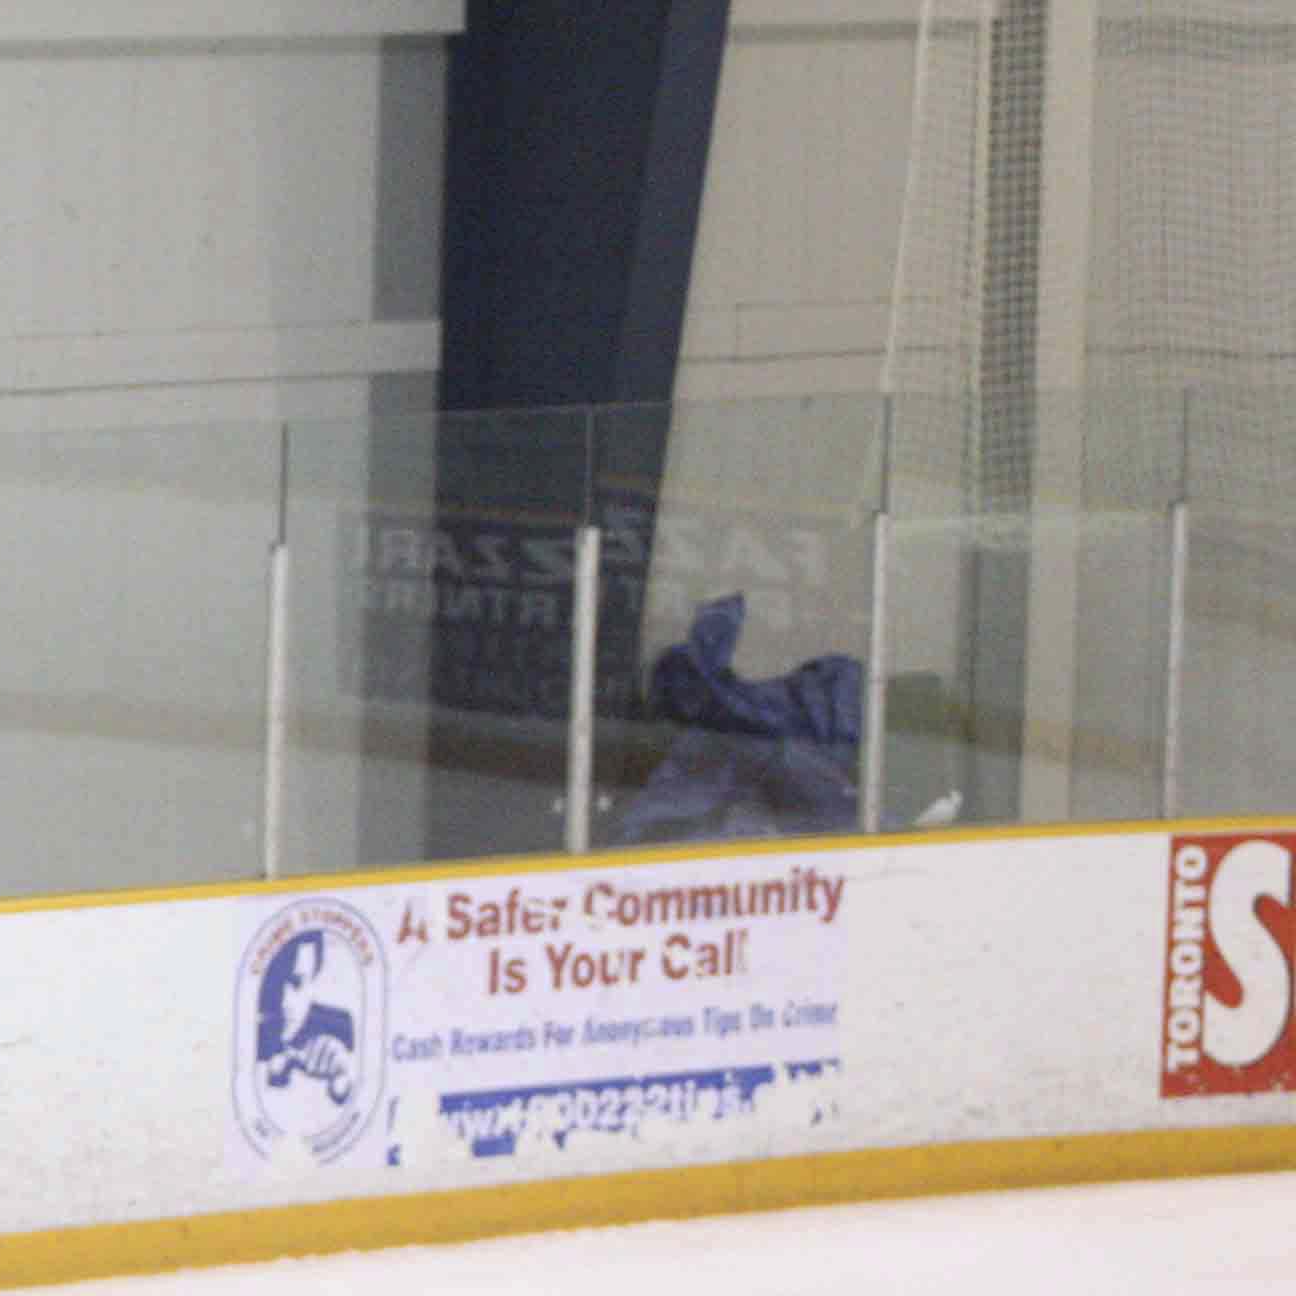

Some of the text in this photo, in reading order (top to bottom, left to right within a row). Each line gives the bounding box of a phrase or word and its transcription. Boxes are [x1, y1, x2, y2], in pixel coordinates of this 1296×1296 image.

[447, 889, 568, 940] Safer
[582, 867, 845, 928] Community
[488, 928, 750, 996] Is Your Call
[1167, 845, 1207, 1072] TORONTO
[1203, 839, 1291, 1067] S
[392, 1032, 442, 1063] Cash
[544, 1020, 574, 1047] For
